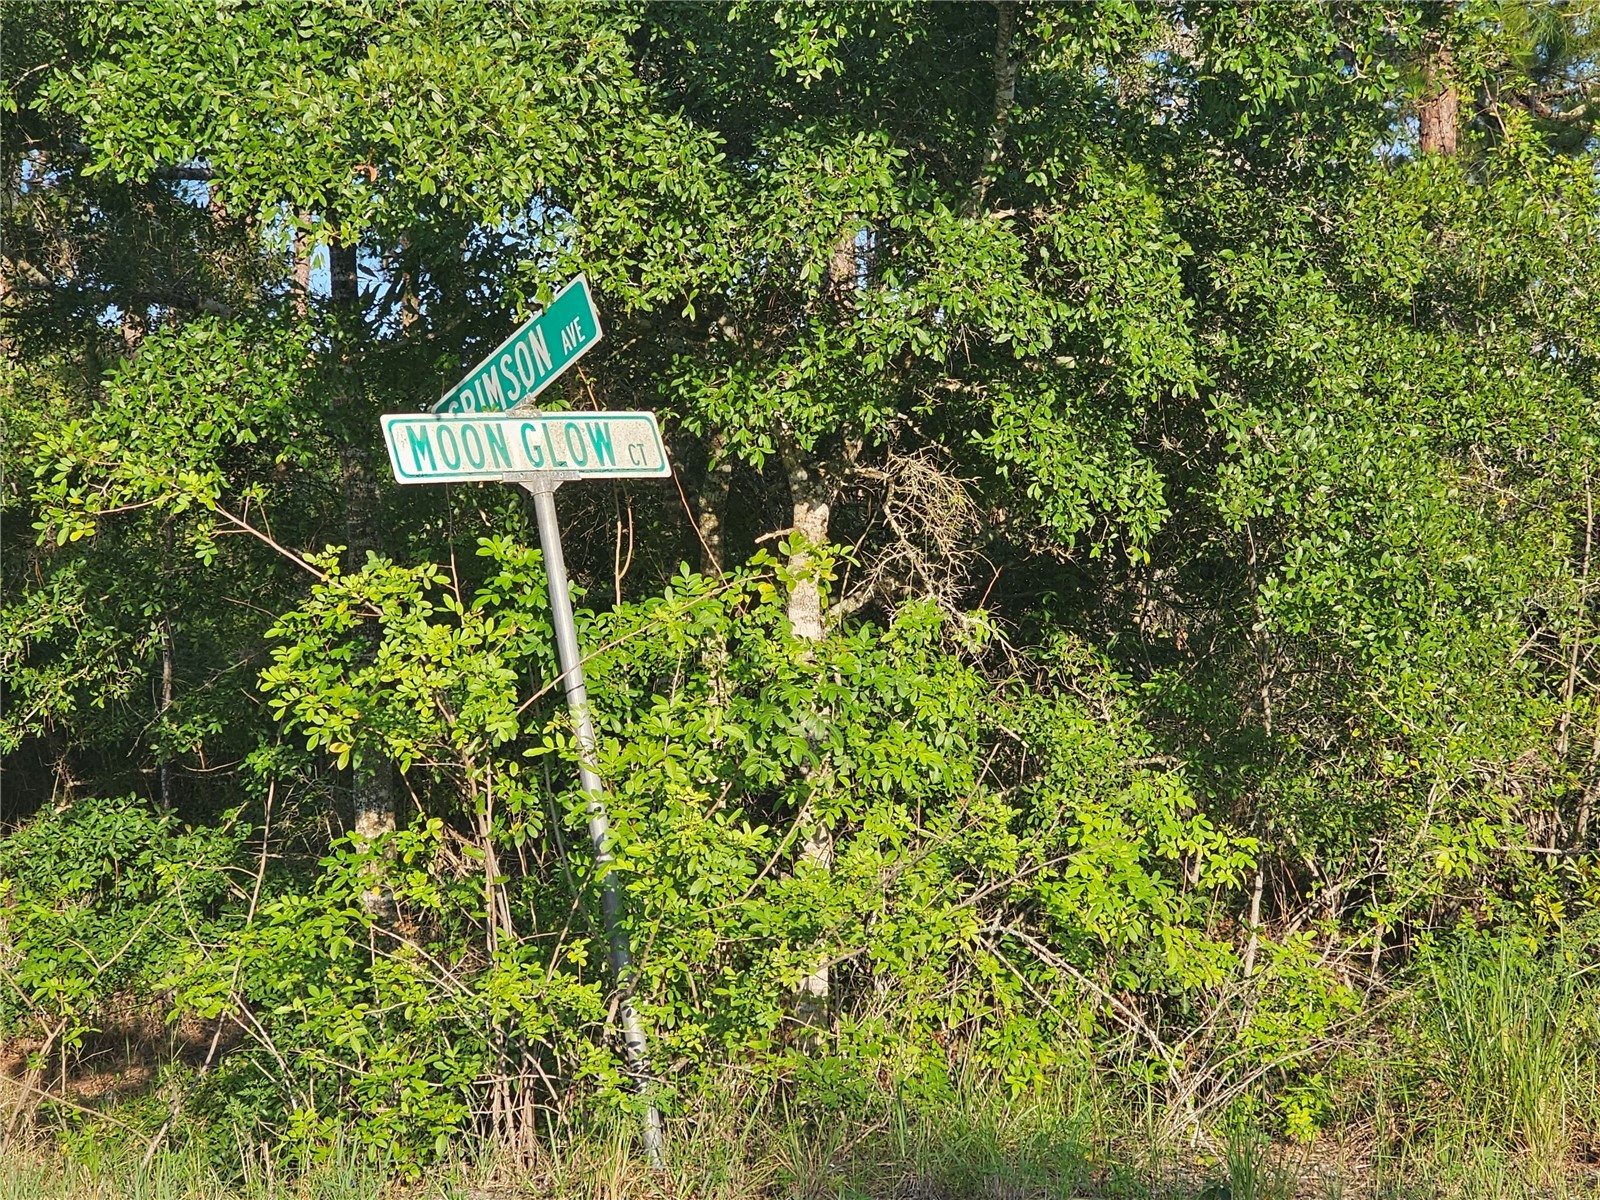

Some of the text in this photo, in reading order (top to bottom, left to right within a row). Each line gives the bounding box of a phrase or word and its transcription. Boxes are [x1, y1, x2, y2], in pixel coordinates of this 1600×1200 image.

[560, 316, 586, 356] AVE
[406, 422, 648, 471] MOON GLOW CT
